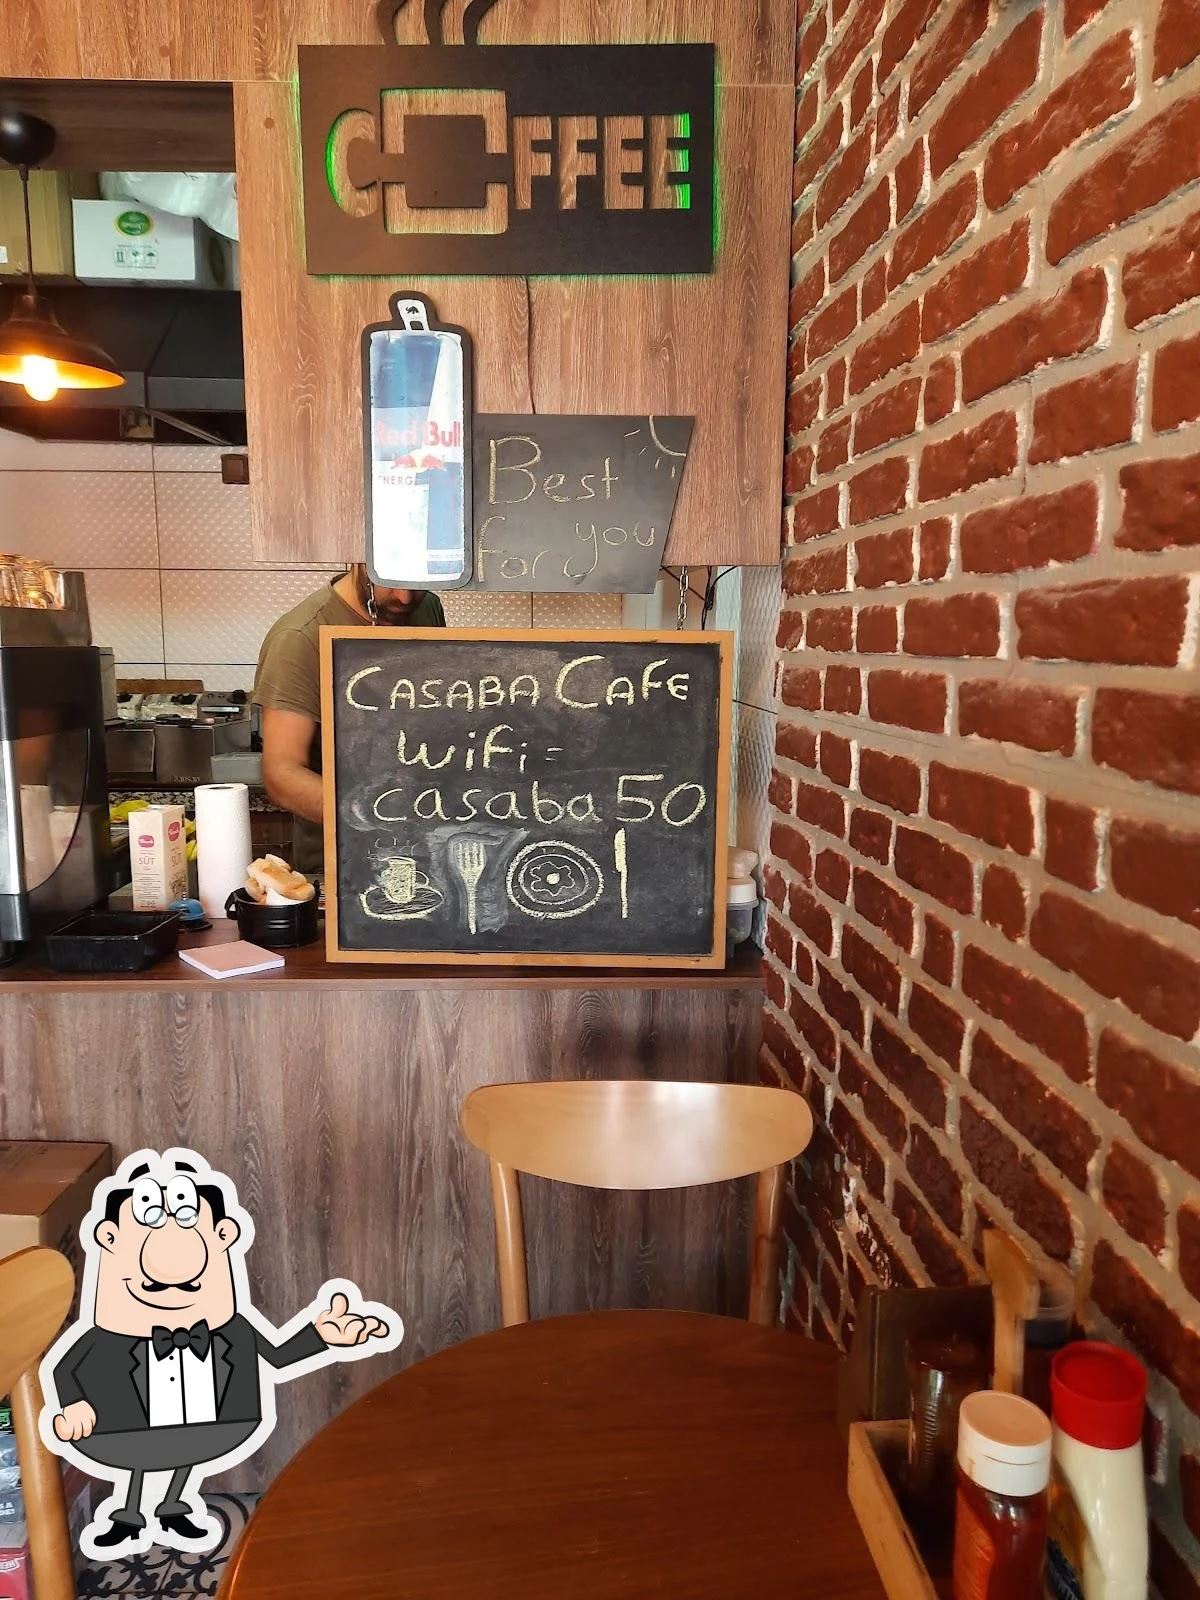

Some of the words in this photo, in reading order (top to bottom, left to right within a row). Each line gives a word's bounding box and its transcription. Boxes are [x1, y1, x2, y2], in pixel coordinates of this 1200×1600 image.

[325, 87, 691, 235] COFFEE
[375, 420, 417, 446] Red
[424, 420, 461, 447] Bull
[490, 435, 619, 504] Best
[563, 521, 655, 577] you
[346, 667, 540, 712] CASABA
